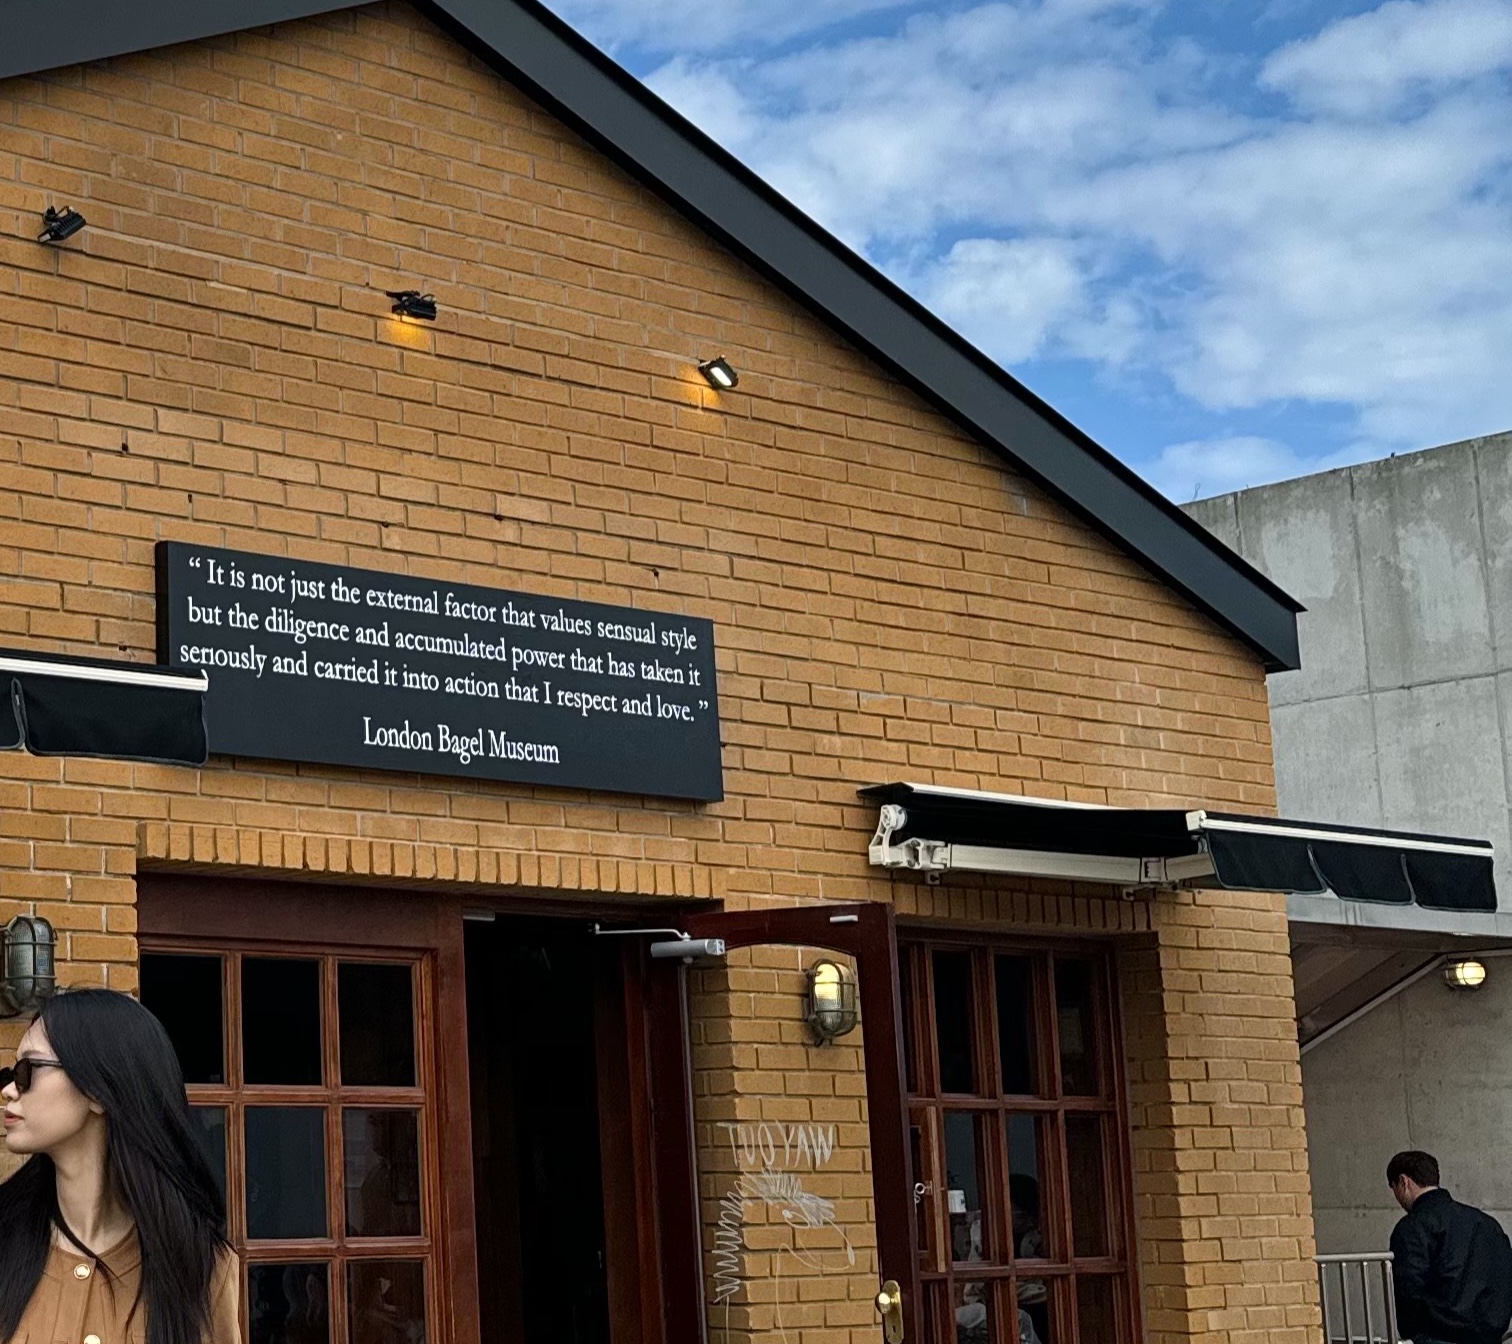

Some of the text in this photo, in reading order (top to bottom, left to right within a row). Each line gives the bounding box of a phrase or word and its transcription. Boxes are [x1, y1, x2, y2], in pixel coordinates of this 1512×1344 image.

[187, 595, 701, 687] but the diligence and accumulated power that has taken it
[229, 561, 246, 589] is
[251, 572, 286, 594] not
[290, 570, 326, 604] just
[330, 576, 361, 605] the
[365, 588, 440, 615] external
[444, 592, 497, 623] factor
[501, 600, 537, 629] that
[539, 608, 592, 636] values
[597, 621, 657, 645] sensual
[661, 626, 698, 656] style
[180, 644, 268, 679] seriously
[272, 650, 309, 677] and
[313, 656, 380, 685] carried
[383, 660, 399, 687] it
[402, 663, 440, 692] into
[444, 671, 500, 699] action
[504, 676, 540, 704] that
[542, 680, 553, 705] I
[556, 689, 618, 718] respect
[621, 692, 653, 717] and
[362, 716, 561, 765] London Bagel Museum
